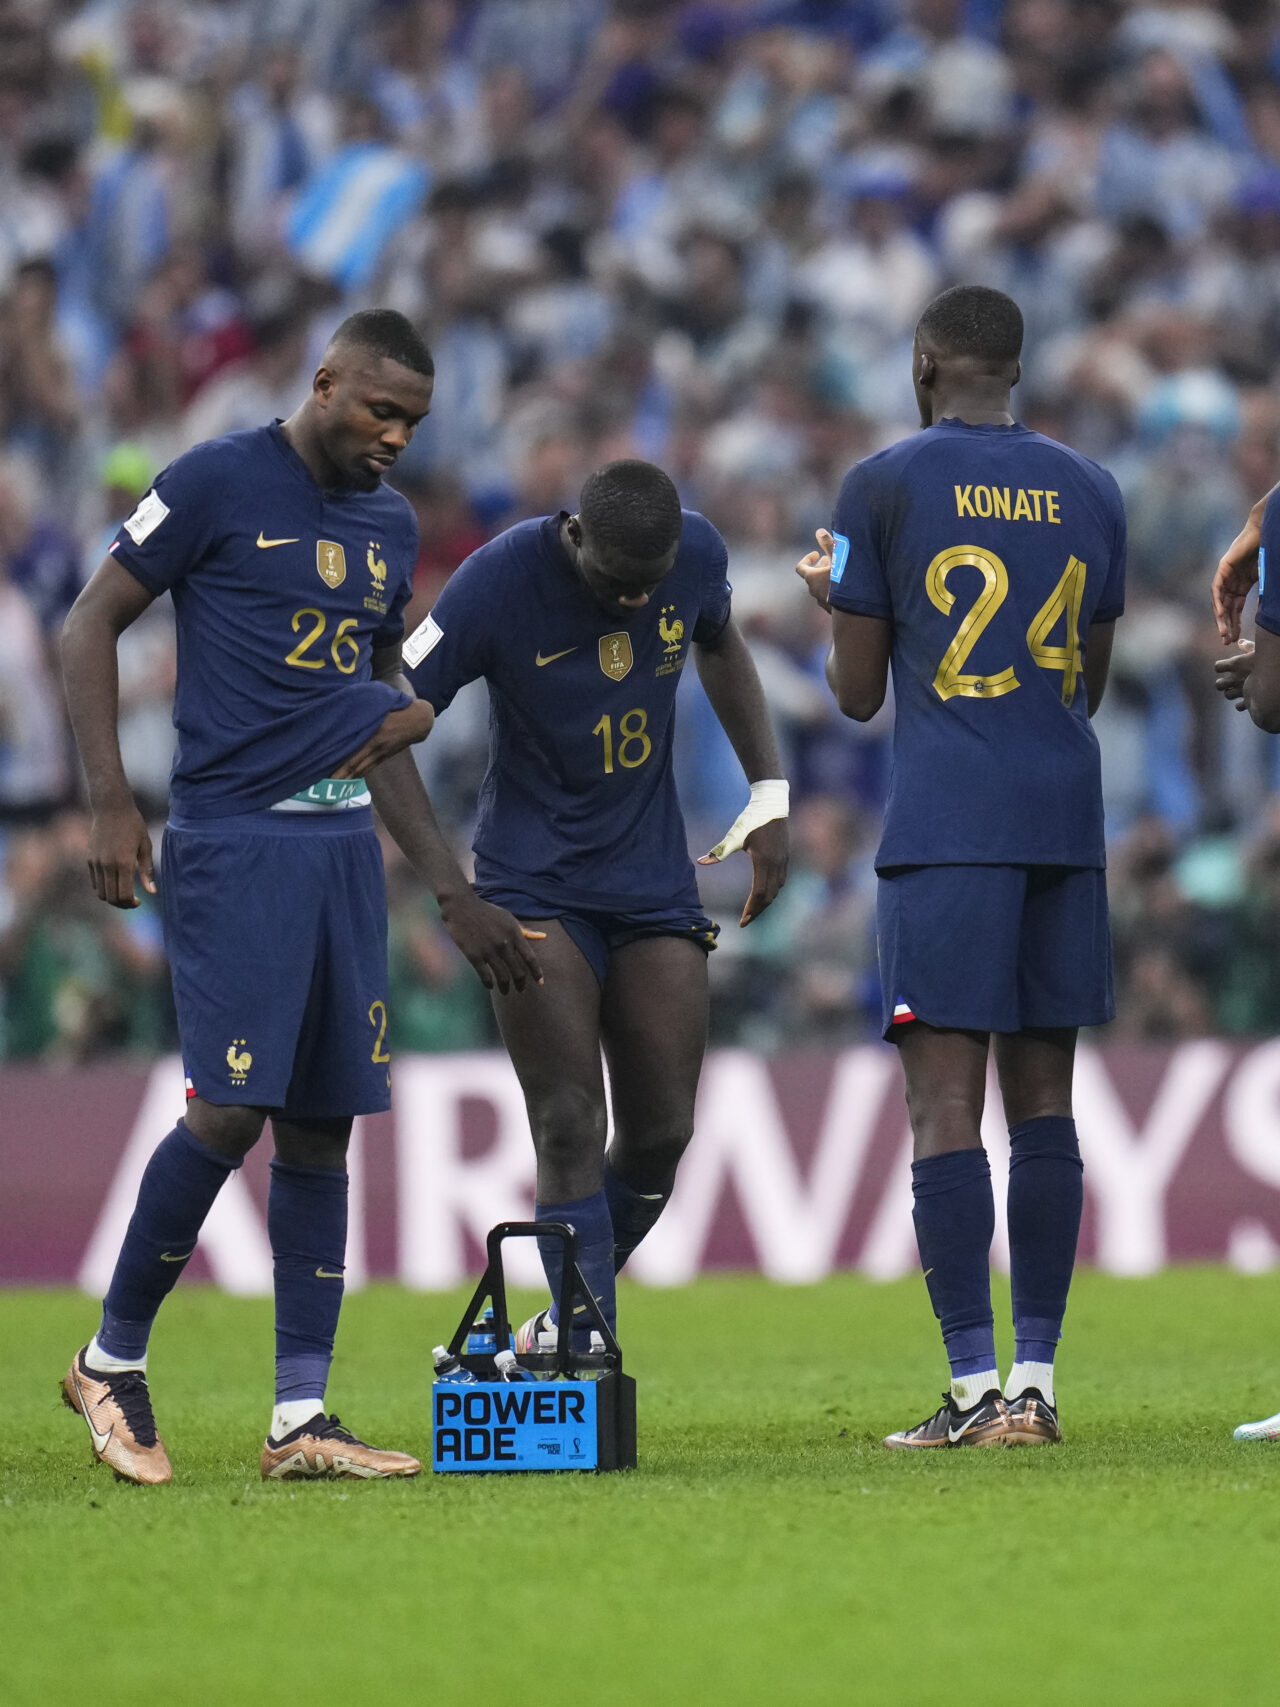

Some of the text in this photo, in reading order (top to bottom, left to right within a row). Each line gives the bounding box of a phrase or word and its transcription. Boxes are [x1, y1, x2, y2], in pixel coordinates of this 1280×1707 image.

[954, 484, 1062, 524] KONATE
[285, 608, 360, 675] 26
[925, 544, 1084, 708] 24
[592, 708, 652, 774] 18
[368, 1000, 391, 1088] 2
[437, 1391, 585, 1426] POWER
[437, 1428, 517, 1462] ADE
